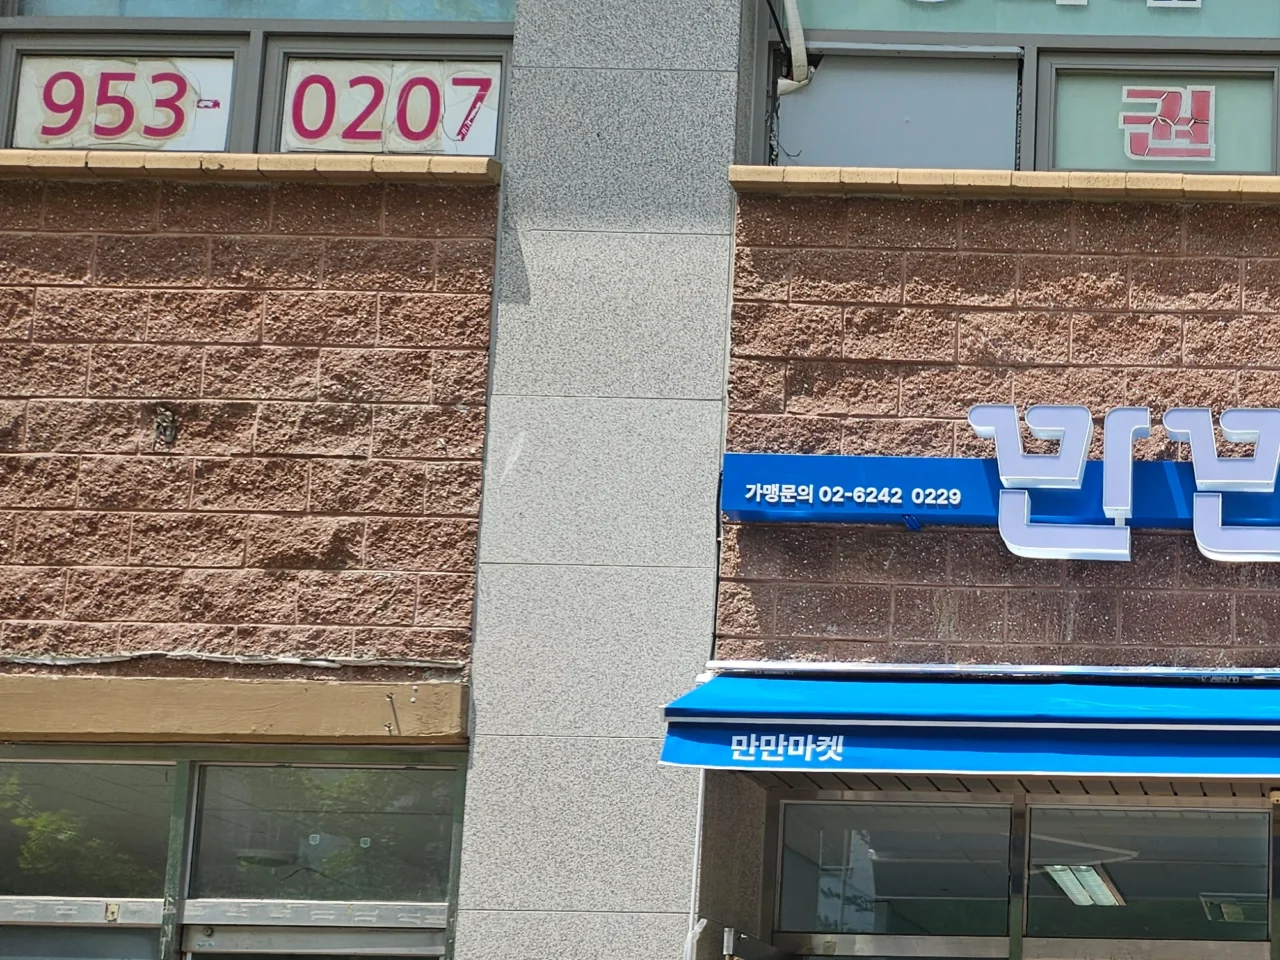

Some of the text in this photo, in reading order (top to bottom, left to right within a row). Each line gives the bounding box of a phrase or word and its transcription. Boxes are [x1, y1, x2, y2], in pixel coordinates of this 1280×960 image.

[292, 75, 493, 142] 0207
[745, 483, 961, 506] 가맹문의 02-6242 0229
[731, 733, 844, 763] 만만마켓
